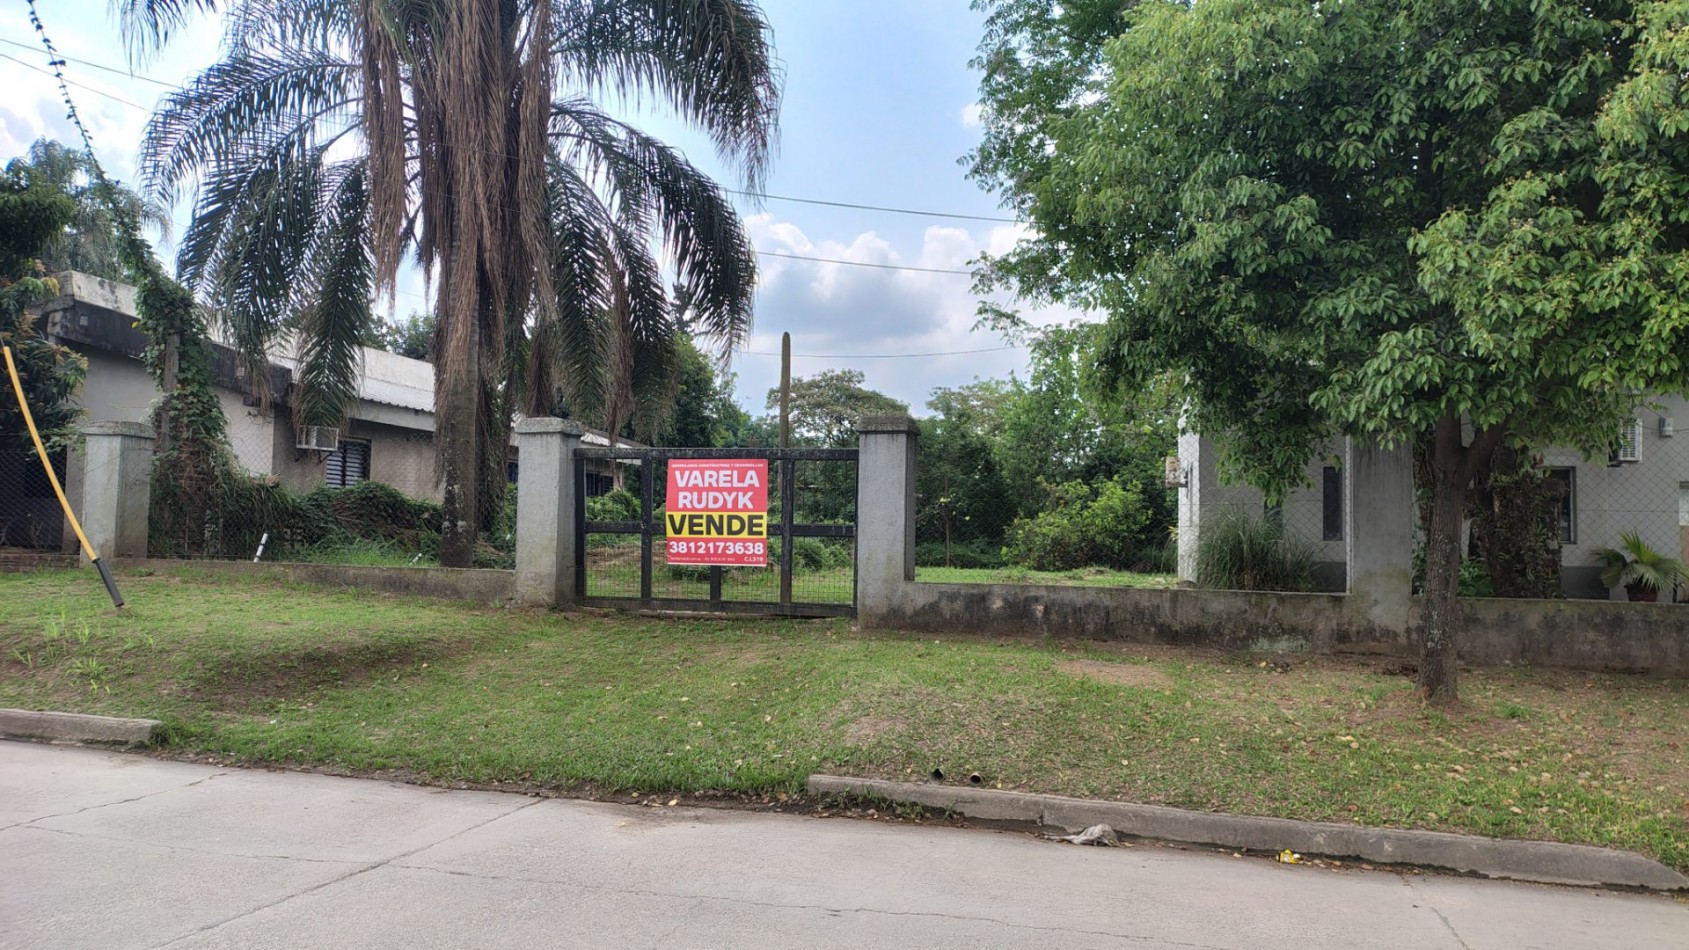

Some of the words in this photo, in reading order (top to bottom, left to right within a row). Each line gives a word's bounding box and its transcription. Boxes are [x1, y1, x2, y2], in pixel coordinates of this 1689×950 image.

[675, 470, 760, 488] VARELA
[678, 491, 754, 509] RUDYK
[668, 514, 764, 536] VENDE
[669, 541, 764, 555] 3812173638
